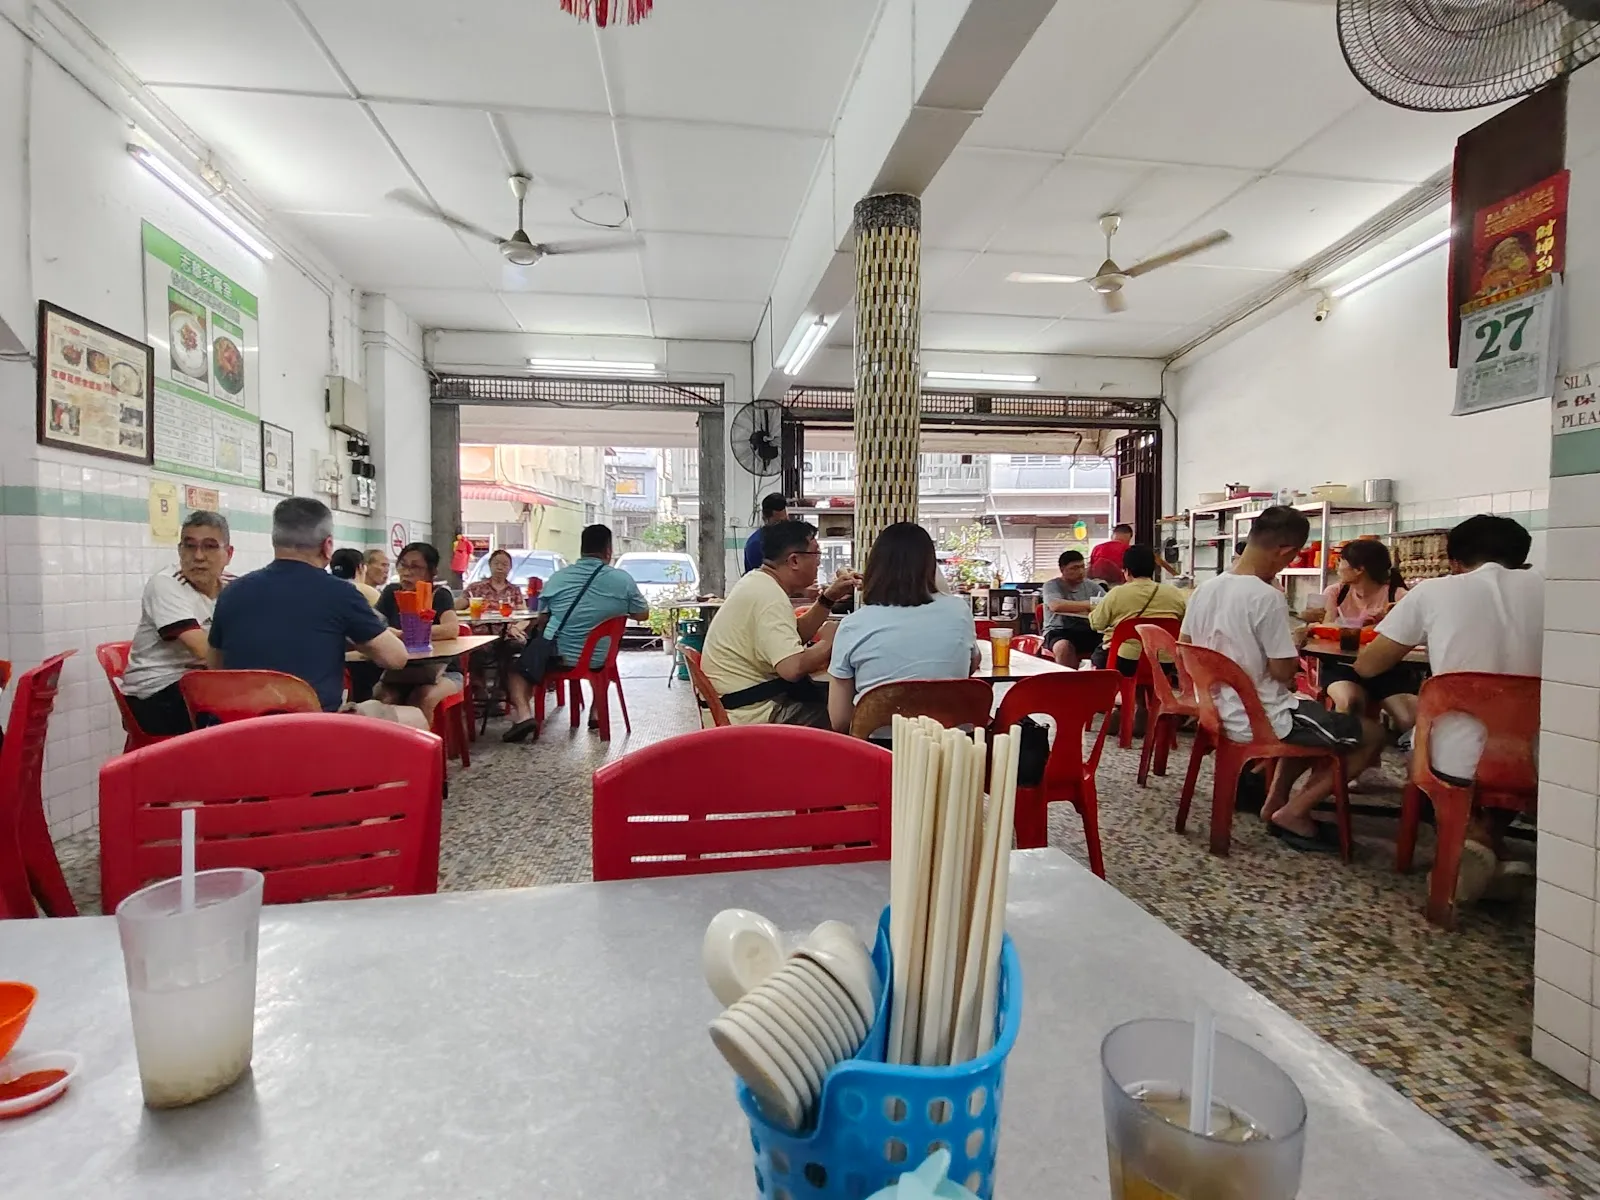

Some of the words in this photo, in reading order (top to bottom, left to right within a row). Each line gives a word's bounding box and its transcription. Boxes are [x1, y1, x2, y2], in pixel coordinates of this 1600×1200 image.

[1475, 306, 1534, 363] 27
[1563, 373, 1592, 391] SILA
[1561, 410, 1600, 429] PLEA
